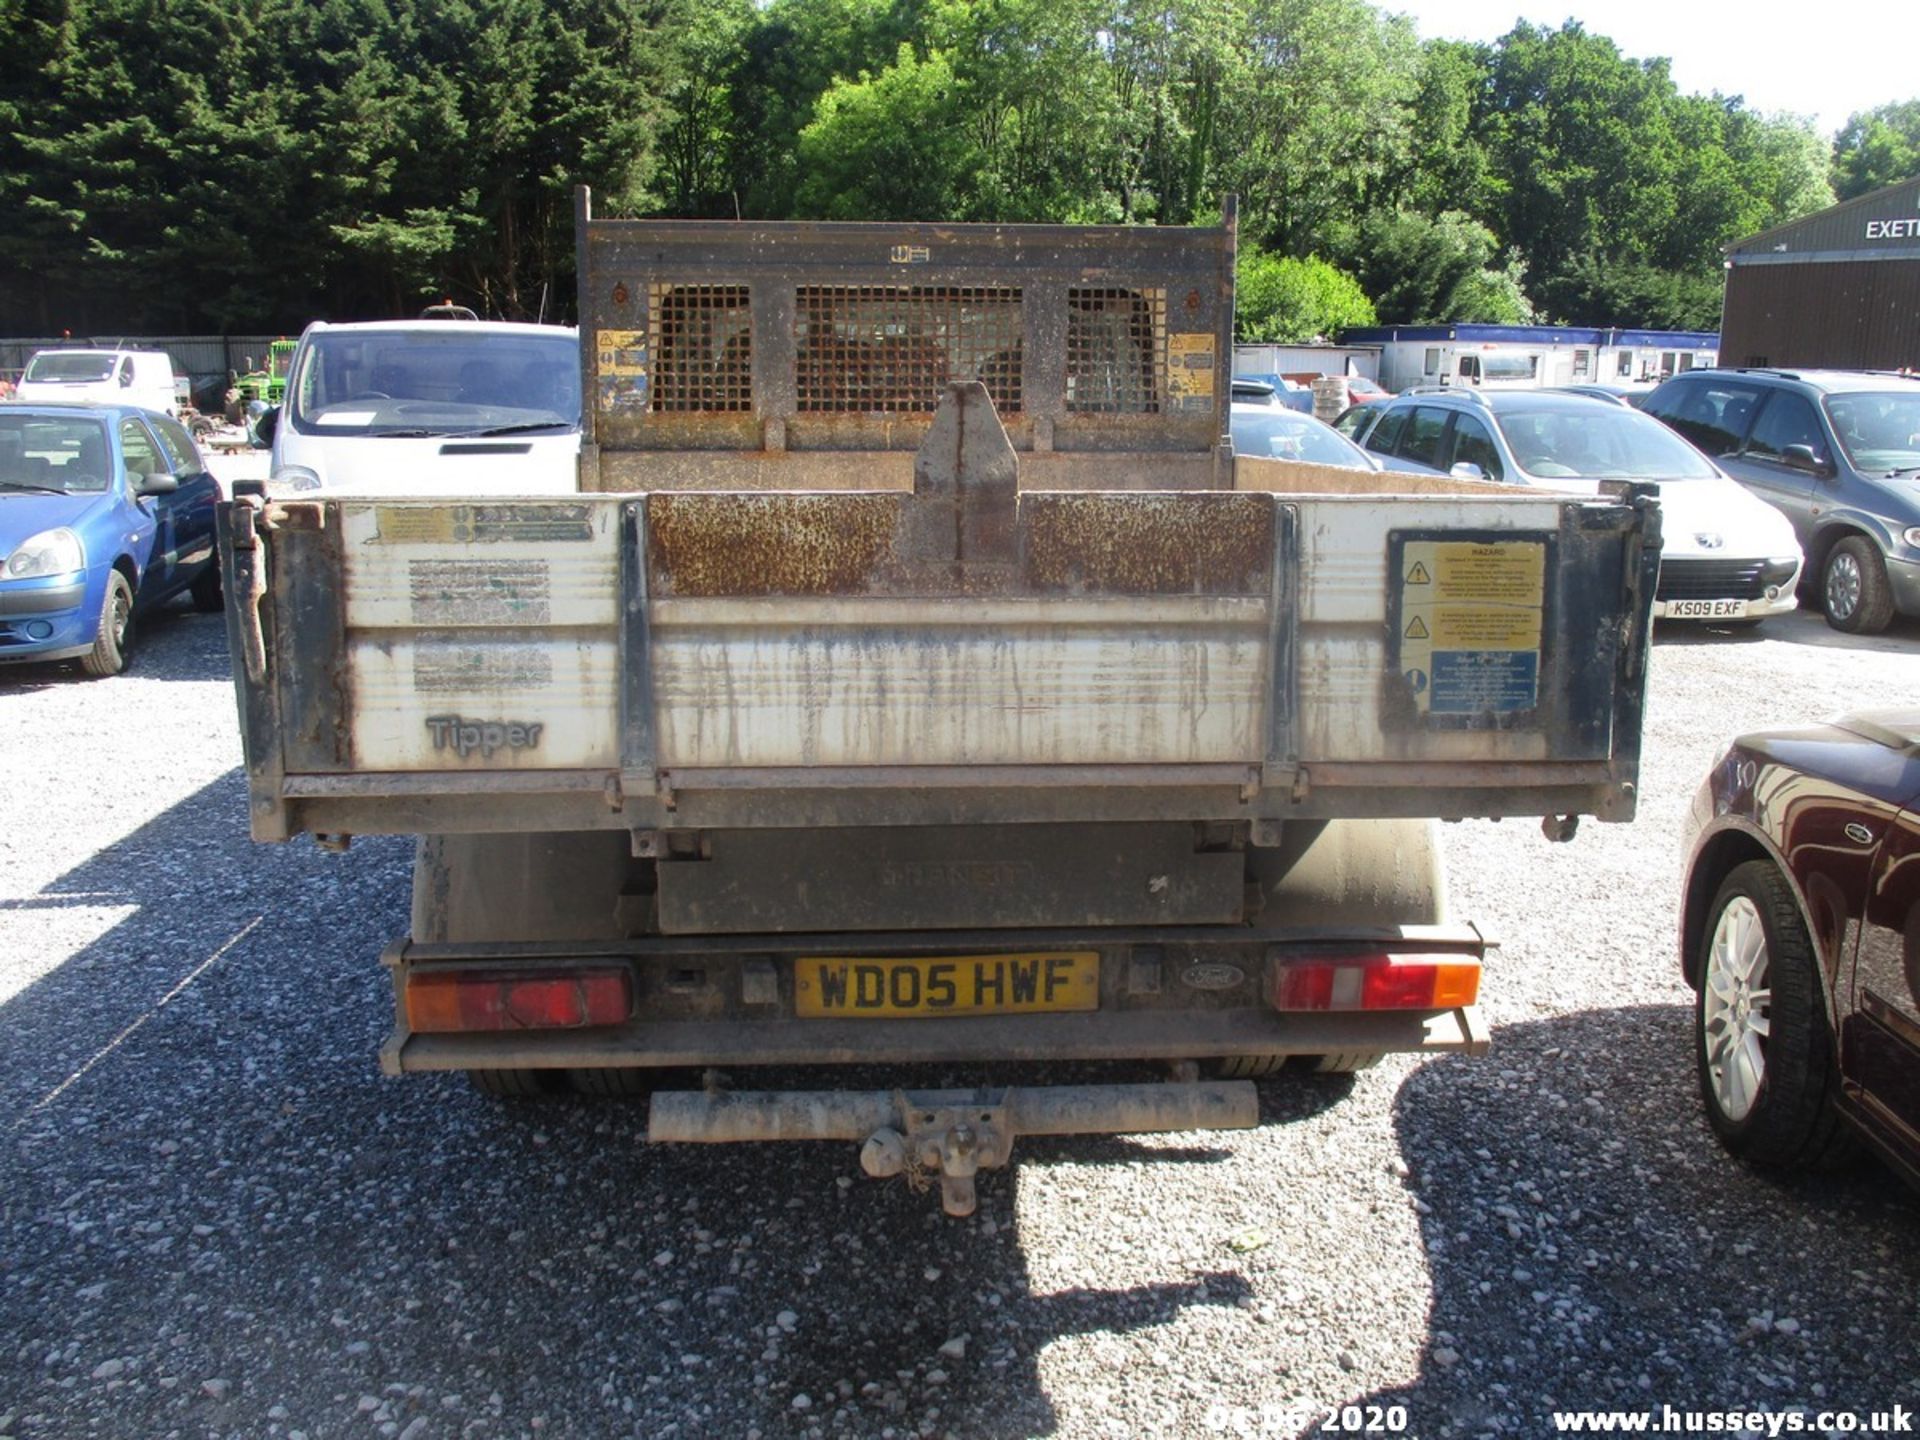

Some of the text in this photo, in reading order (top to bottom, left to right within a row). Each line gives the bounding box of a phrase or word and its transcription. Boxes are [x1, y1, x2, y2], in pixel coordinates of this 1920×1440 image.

[1471, 548, 1506, 556] HAZARD
[1674, 601, 1741, 615] KS09 EXF
[425, 714, 544, 758] Tipper
[819, 958, 1075, 1008] WD05 HWF
